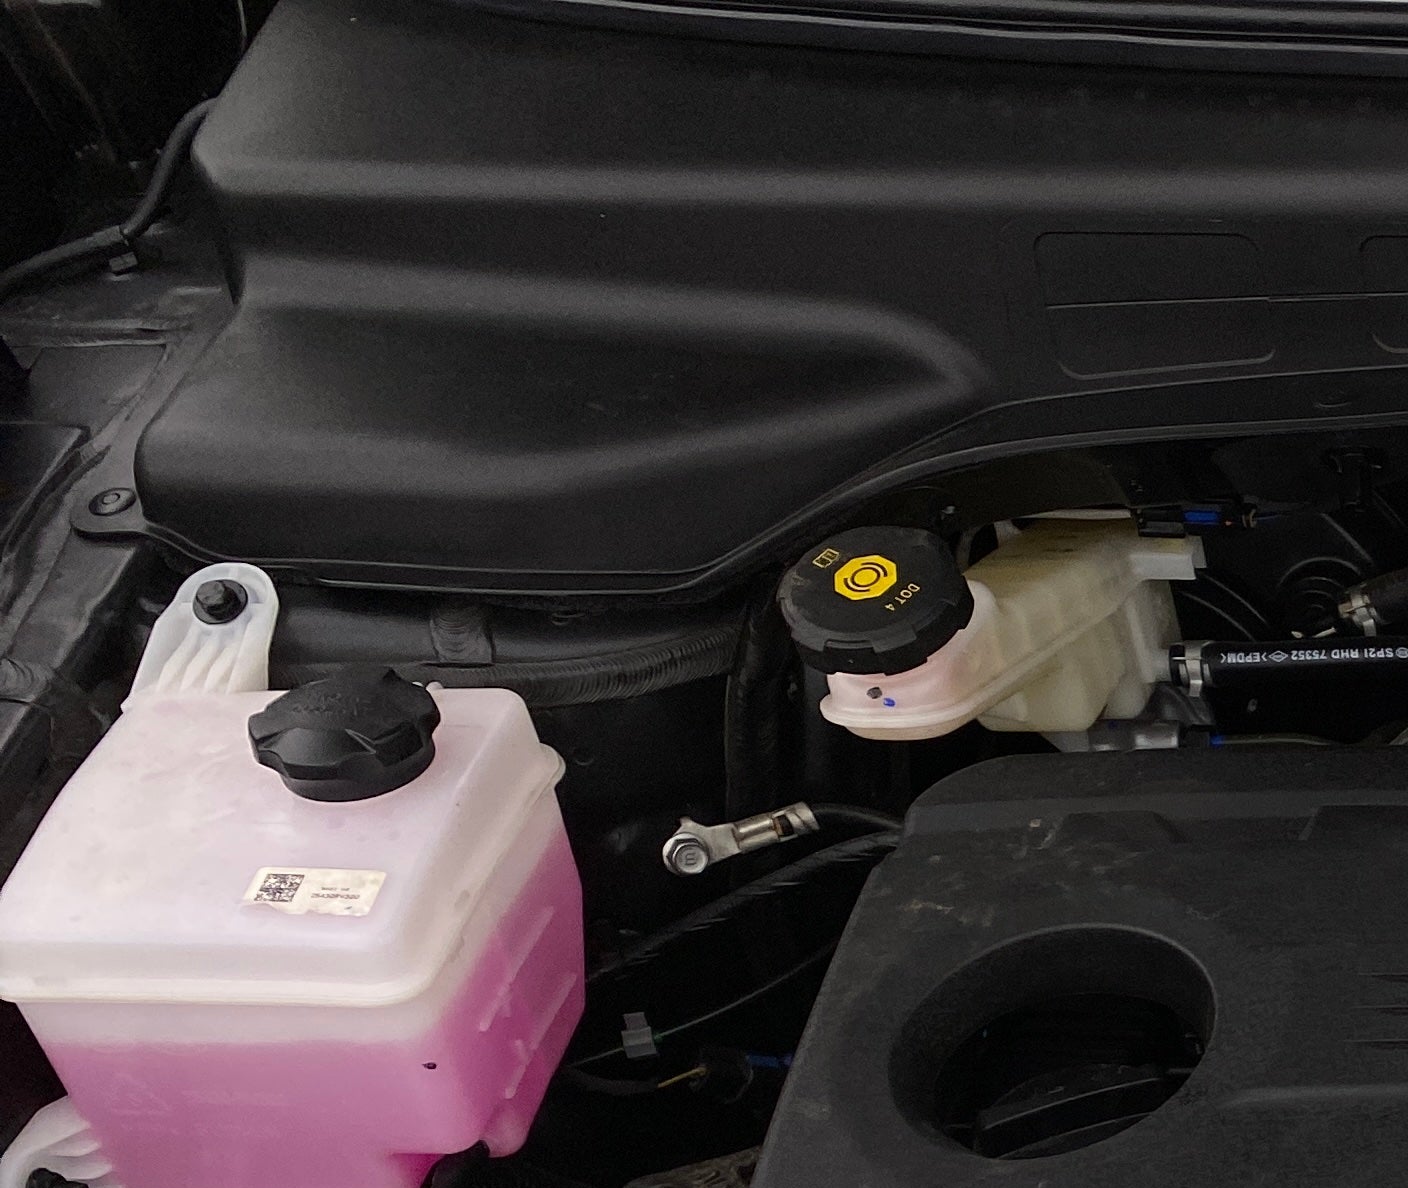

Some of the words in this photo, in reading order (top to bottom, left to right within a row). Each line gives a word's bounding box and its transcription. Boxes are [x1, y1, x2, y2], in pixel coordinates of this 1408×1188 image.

[894, 583, 921, 605] DOT
[885, 603, 896, 611] 4
[1290, 649, 1327, 660] 75352
[1331, 648, 1359, 659] RHD
